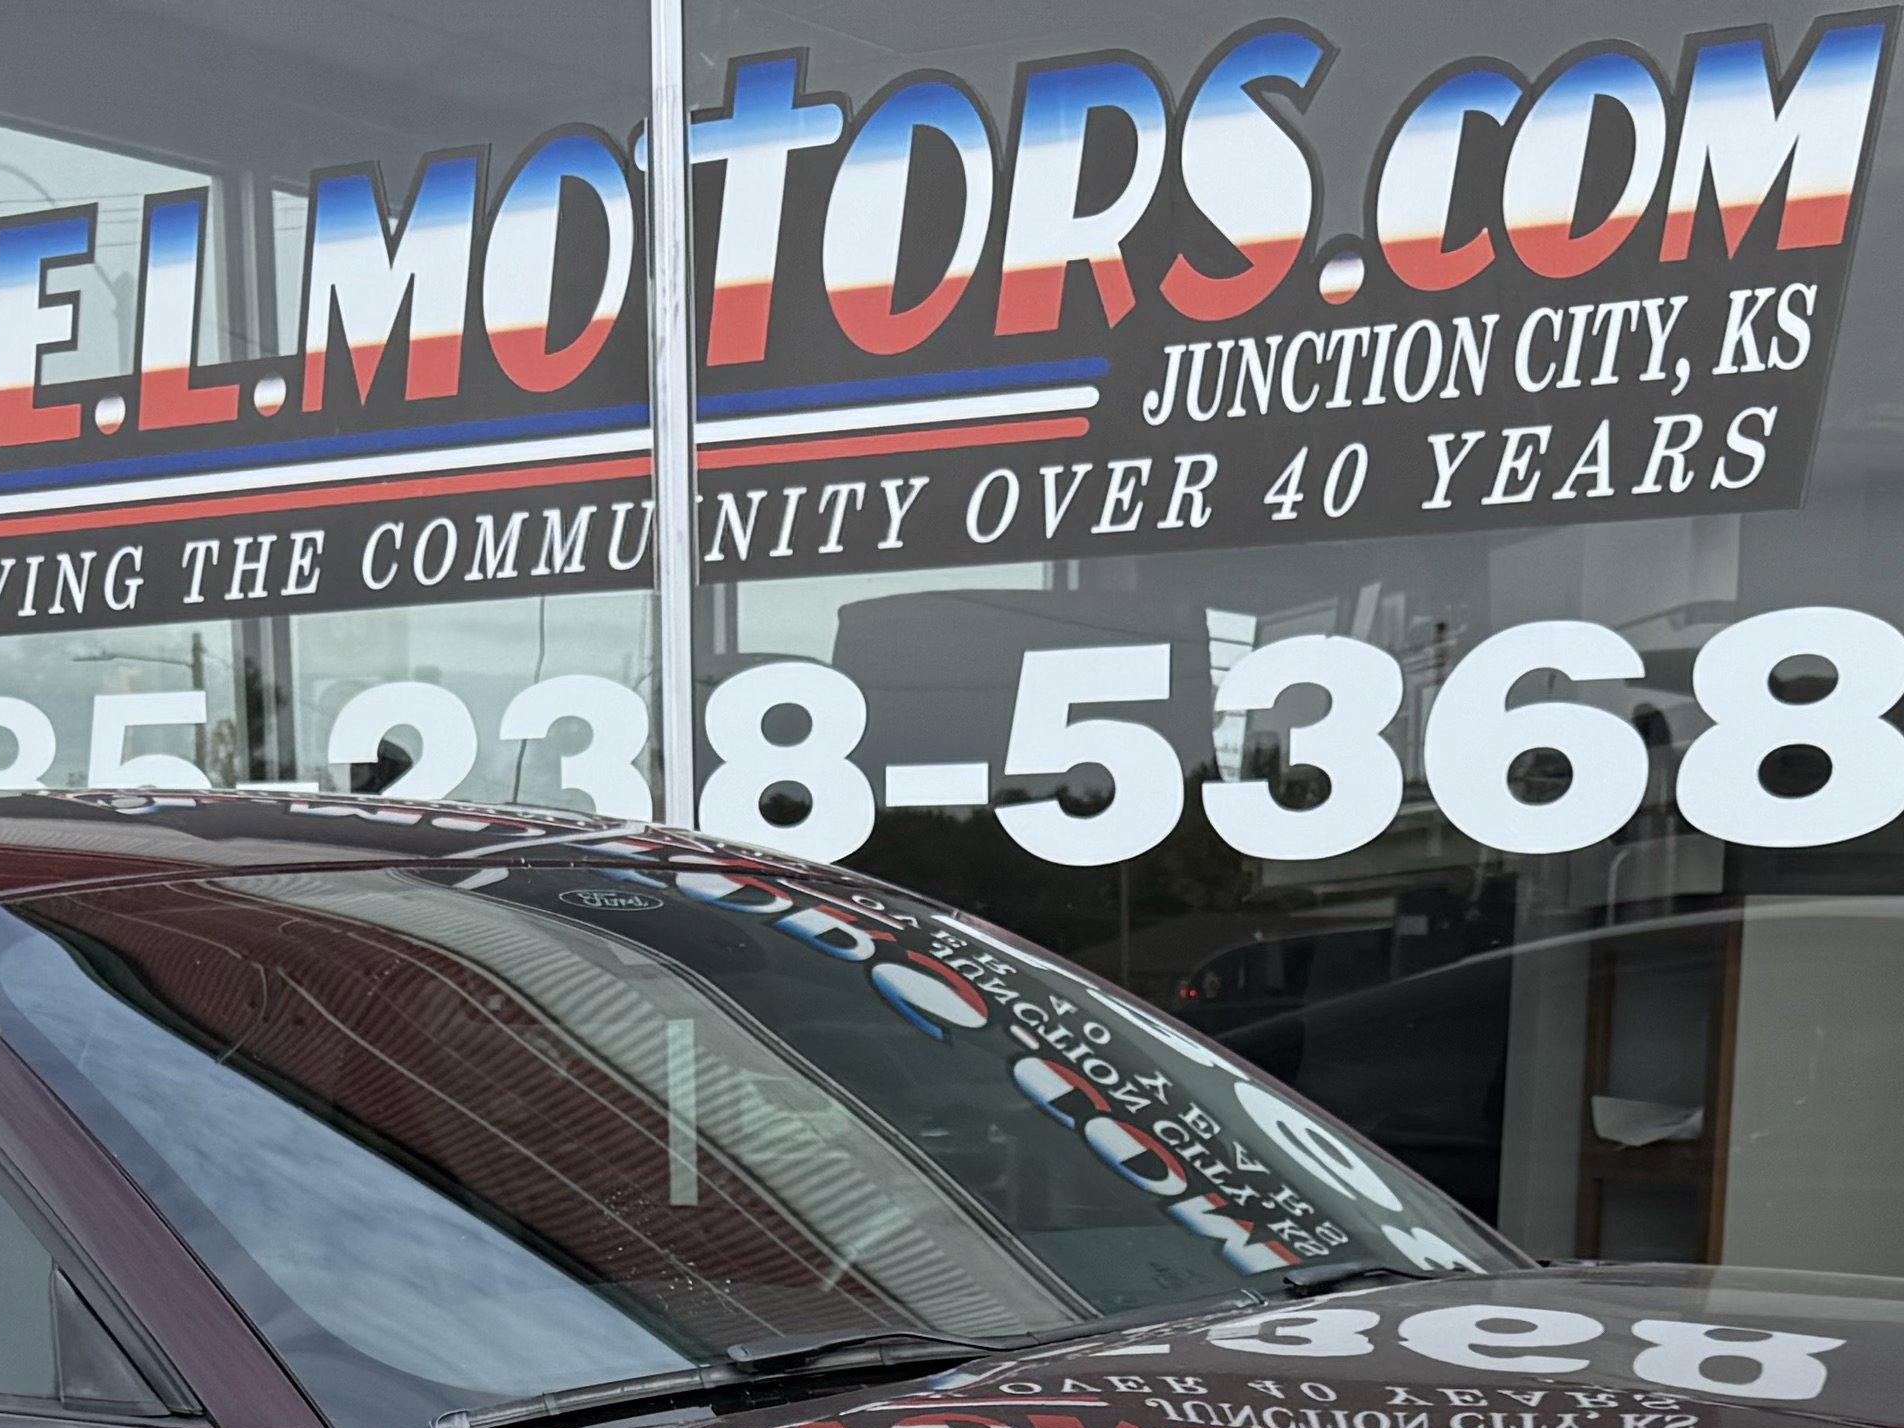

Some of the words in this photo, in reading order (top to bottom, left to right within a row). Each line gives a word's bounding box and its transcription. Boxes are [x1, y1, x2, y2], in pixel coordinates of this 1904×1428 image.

[1142, 314, 1498, 425] JUNCTION
[1514, 296, 1690, 396] CITY,
[1713, 283, 1818, 375] KS
[181, 530, 326, 603] THE
[361, 476, 929, 590] COMMUNITY
[966, 453, 1218, 543] OVER
[1263, 443, 1368, 521] 40
[1421, 406, 1778, 511] YEARS
